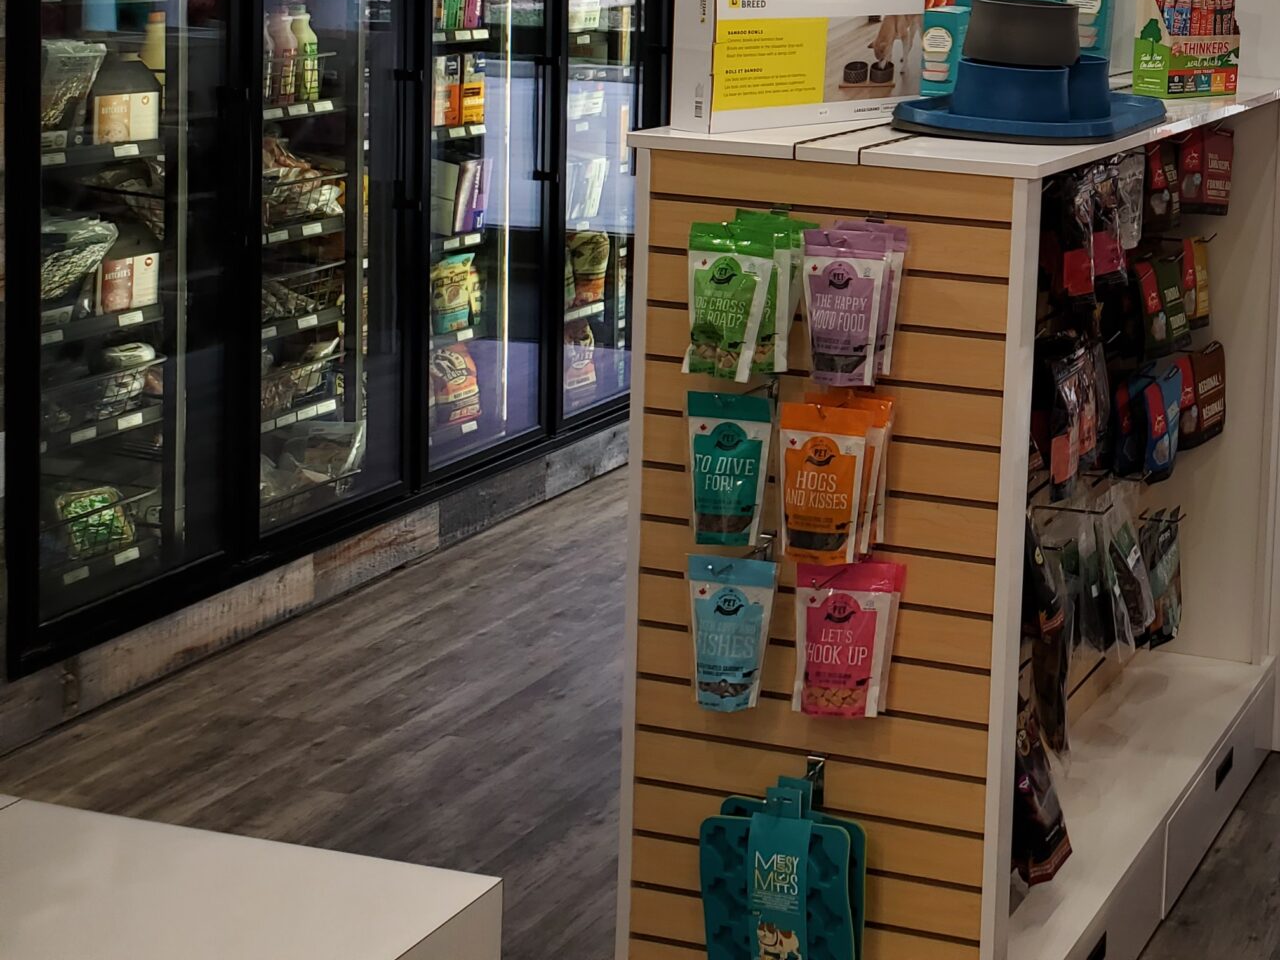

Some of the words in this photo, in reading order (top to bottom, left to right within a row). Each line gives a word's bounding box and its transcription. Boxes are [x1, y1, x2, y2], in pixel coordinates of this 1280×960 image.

[742, 0, 767, 9] BREED
[1183, 42, 1230, 56] THINKERS
[709, 297, 746, 313] CROSS
[815, 293, 833, 308] THE
[834, 296, 868, 311] HAPPY
[707, 311, 743, 328] ROAD?
[837, 312, 865, 332] FOOD
[814, 448, 827, 457] PET
[695, 453, 712, 473] TO
[715, 457, 756, 476] DIVE
[796, 471, 837, 493] HOGS
[785, 488, 806, 507] AND
[808, 490, 848, 510] KISSES
[821, 628, 854, 644] LET'S
[807, 641, 842, 665] HOOK
[848, 646, 868, 666] UP
